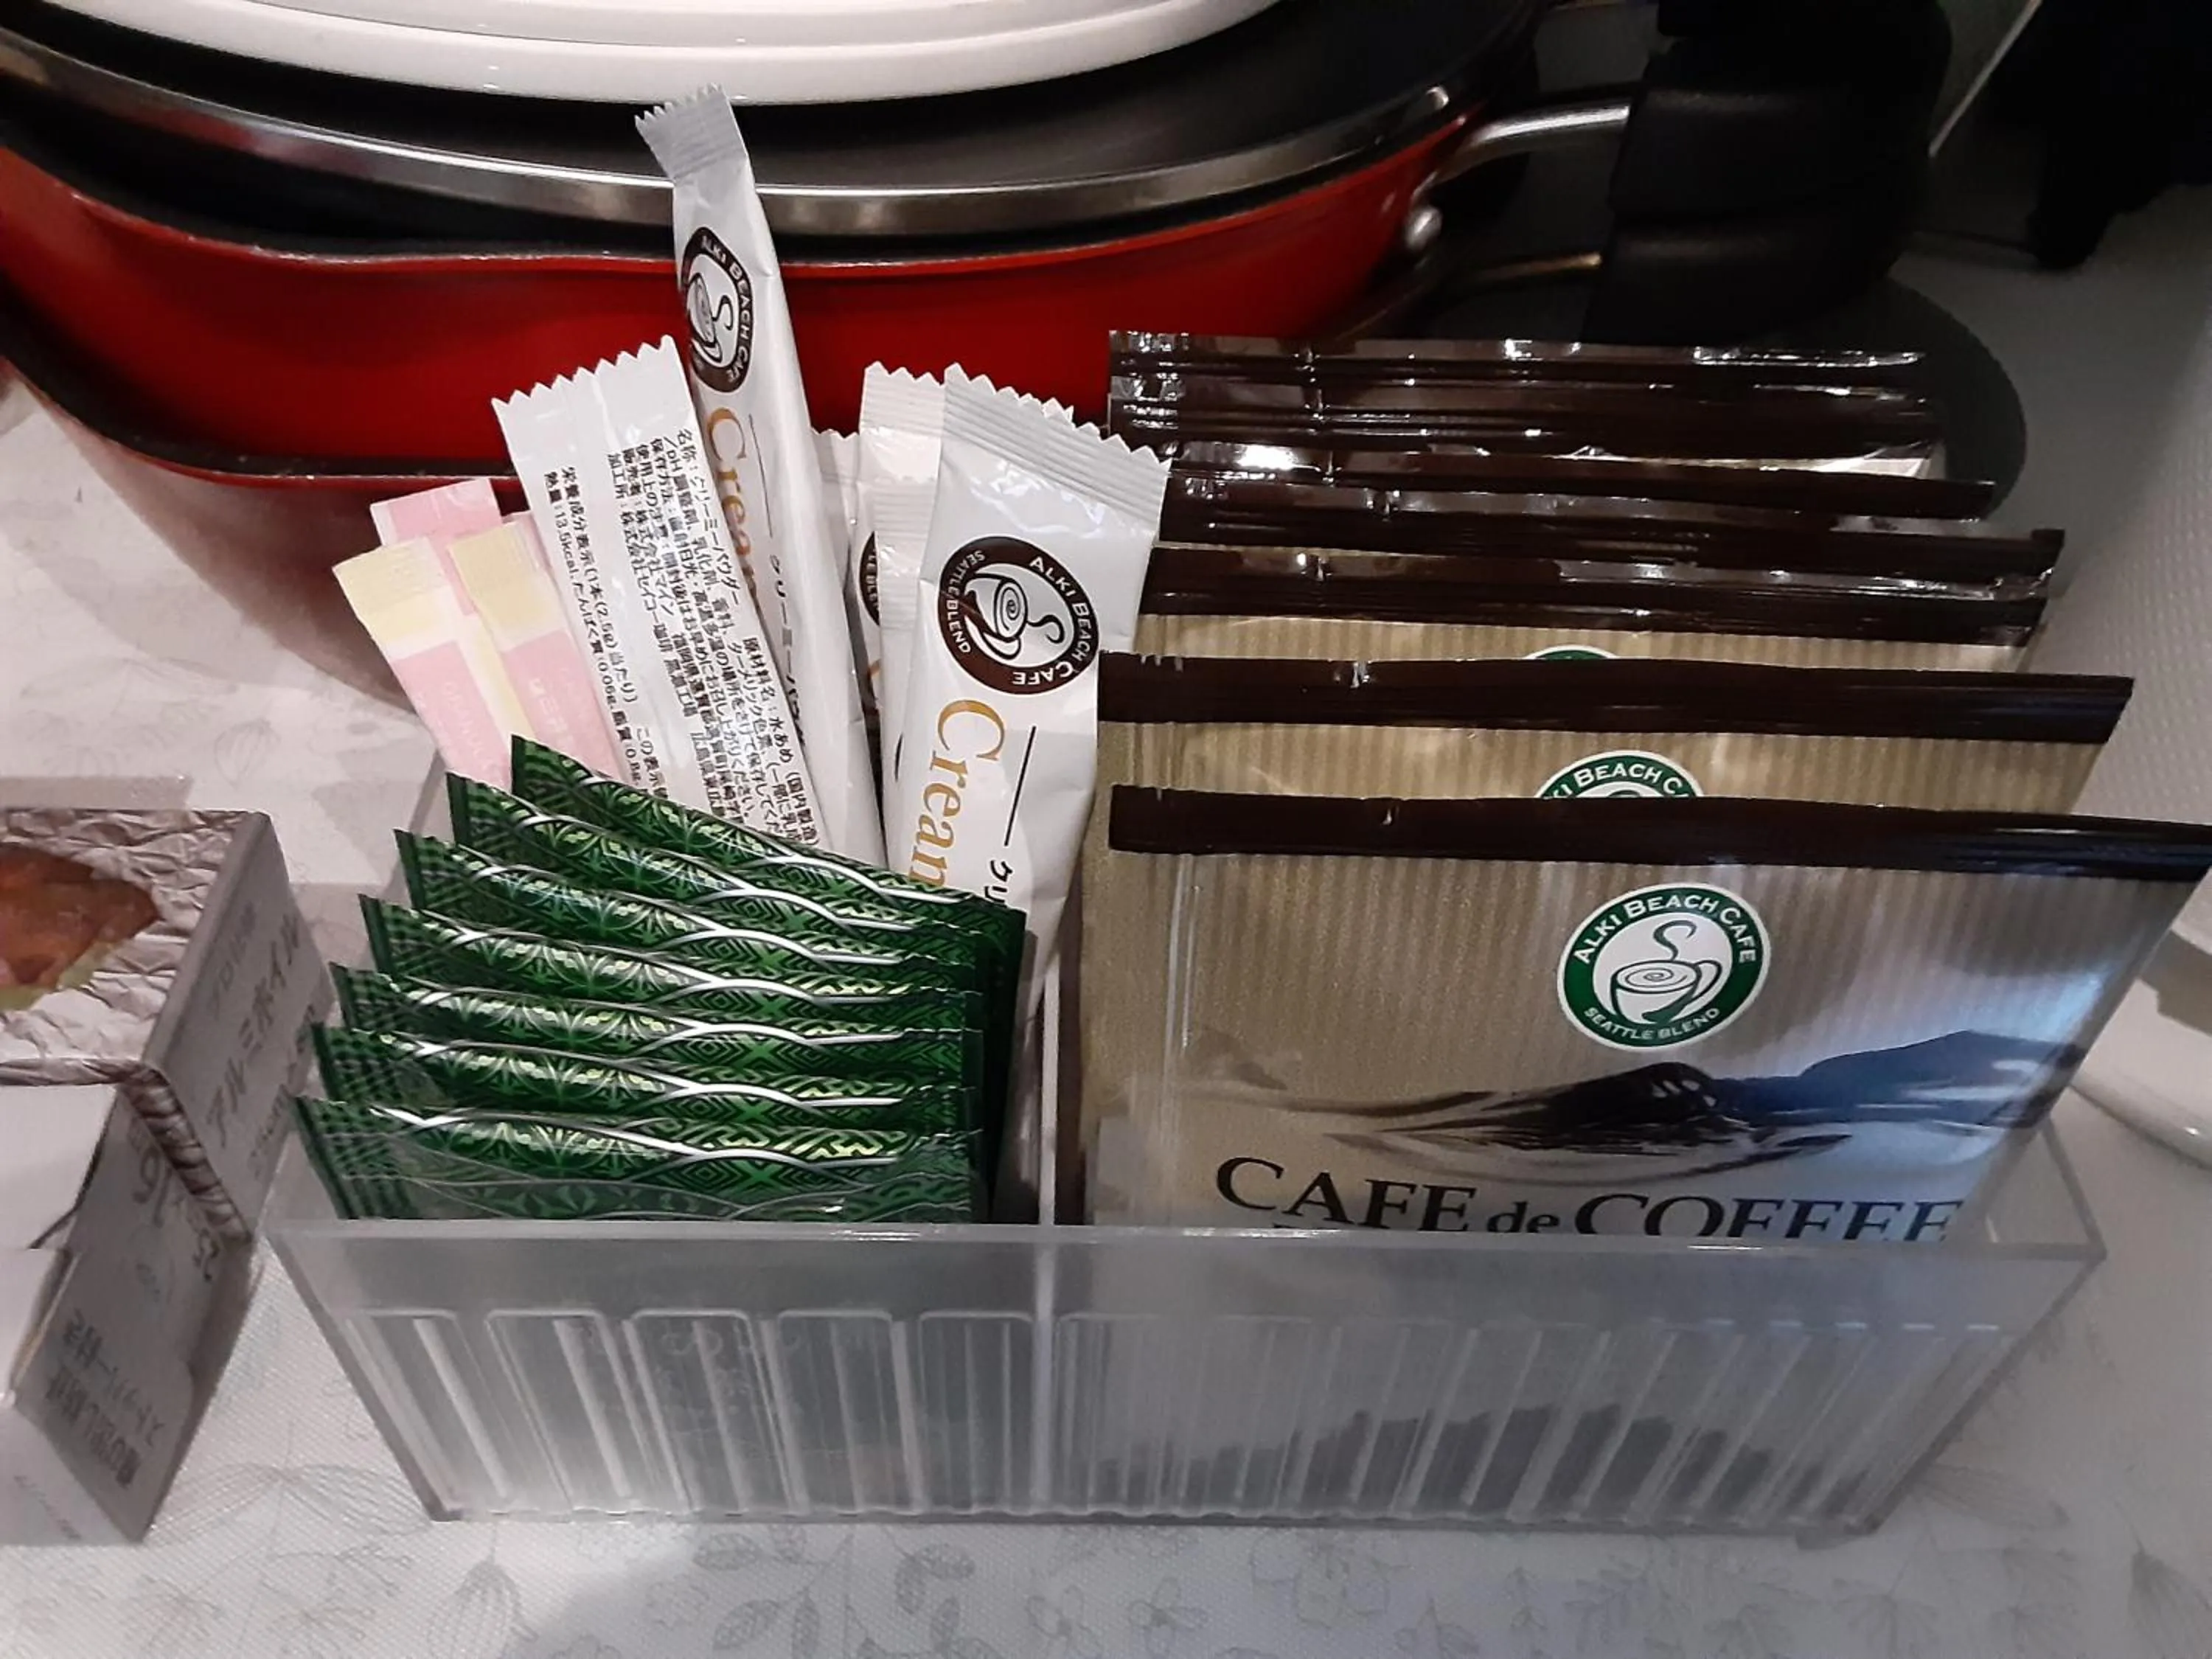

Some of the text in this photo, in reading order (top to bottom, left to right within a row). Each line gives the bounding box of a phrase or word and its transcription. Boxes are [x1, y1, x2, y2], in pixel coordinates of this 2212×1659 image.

[728, 263, 751, 341] BEACH
[947, 550, 985, 653] SEATTLE BLEND
[1012, 556, 1092, 686] ALKI BEACH CAFE
[1574, 763, 1663, 788] BEACH
[1574, 894, 1756, 964] ALKI BEACH CAFE
[1583, 1007, 1720, 1040] SEATTLE BLEND
[1217, 1156, 1478, 1232] CAFE
[1486, 1201, 1560, 1234] de
